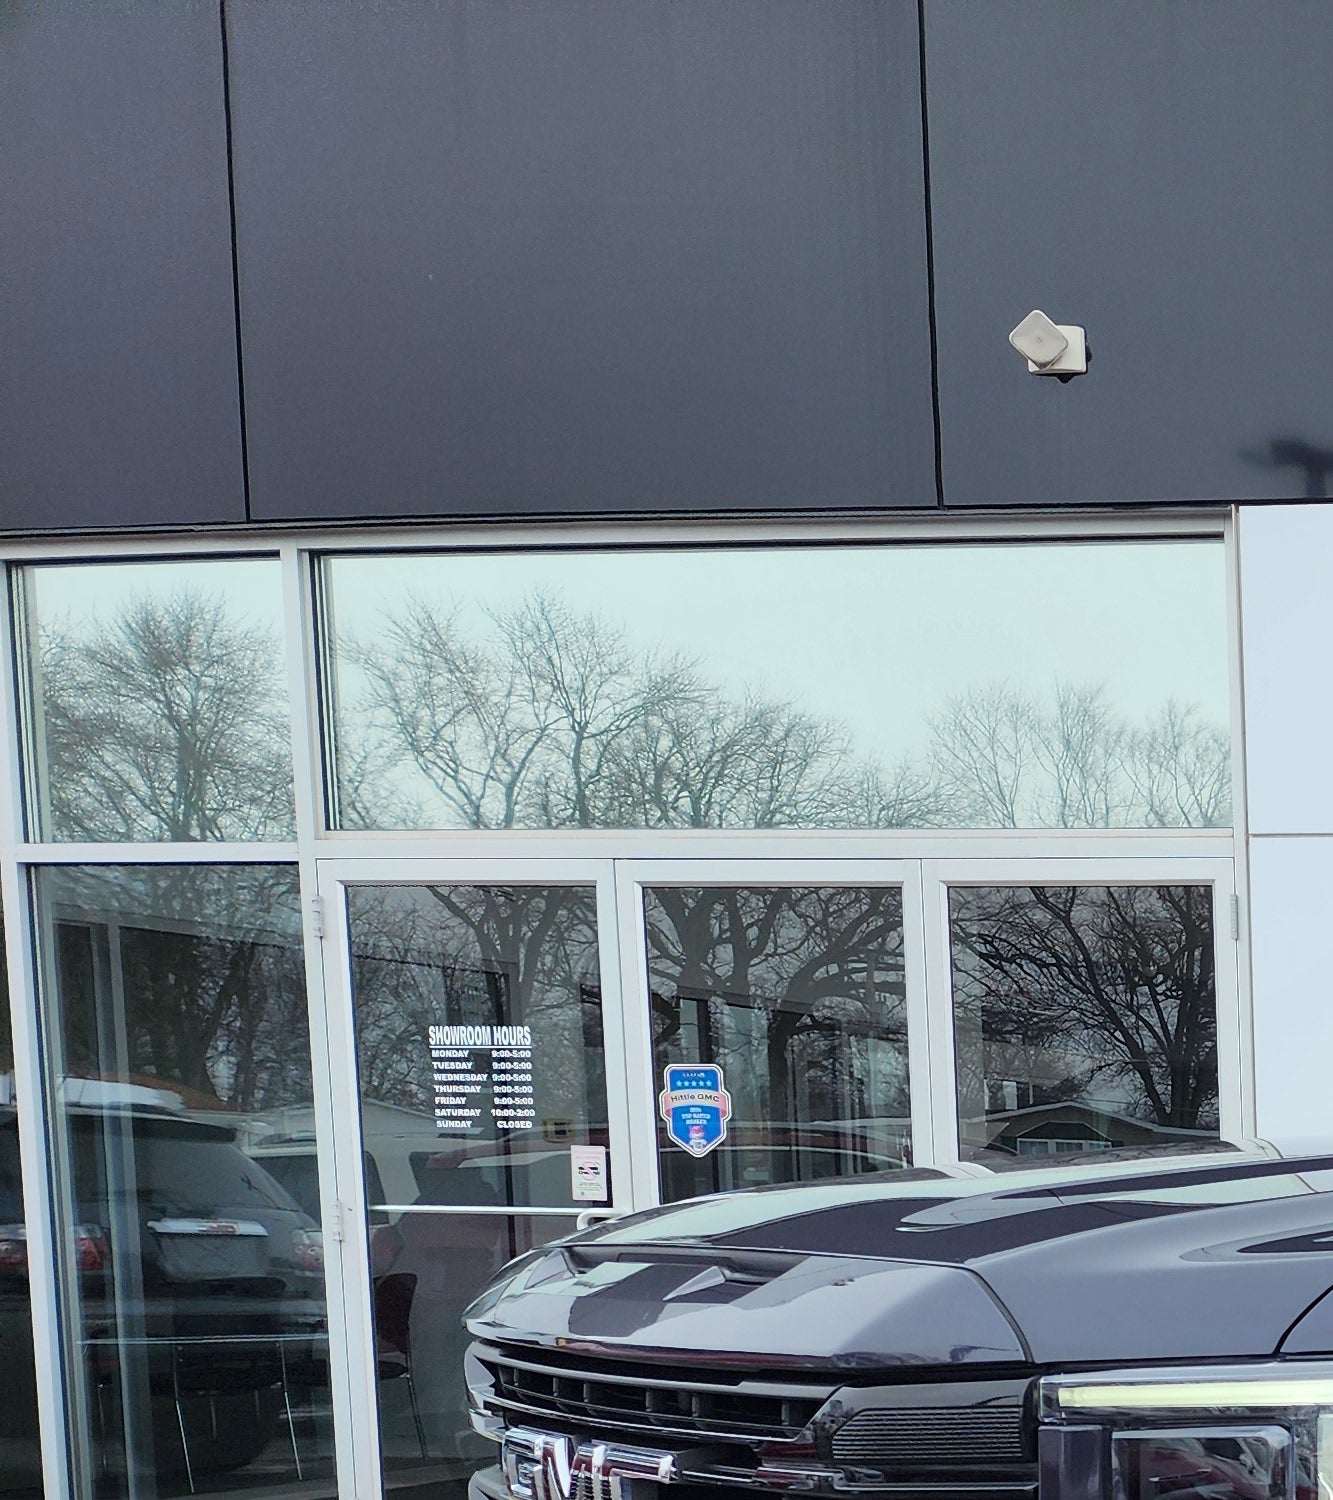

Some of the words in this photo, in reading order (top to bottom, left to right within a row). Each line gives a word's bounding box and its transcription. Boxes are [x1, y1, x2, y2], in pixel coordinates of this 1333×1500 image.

[428, 1025, 491, 1046] SHOWROOM
[493, 1025, 532, 1046] HOURS
[431, 1050, 469, 1058] MONDAY
[432, 1061, 473, 1070] TUESDAY
[433, 1073, 488, 1082] WEDNESDAY
[433, 1085, 482, 1093] THURSDAY
[434, 1097, 467, 1105] FRIDAY
[697, 1093, 720, 1103] GMC
[434, 1108, 481, 1117] SATURDAY
[436, 1120, 473, 1128] SUNDAY
[496, 1120, 533, 1129] CLOSED
